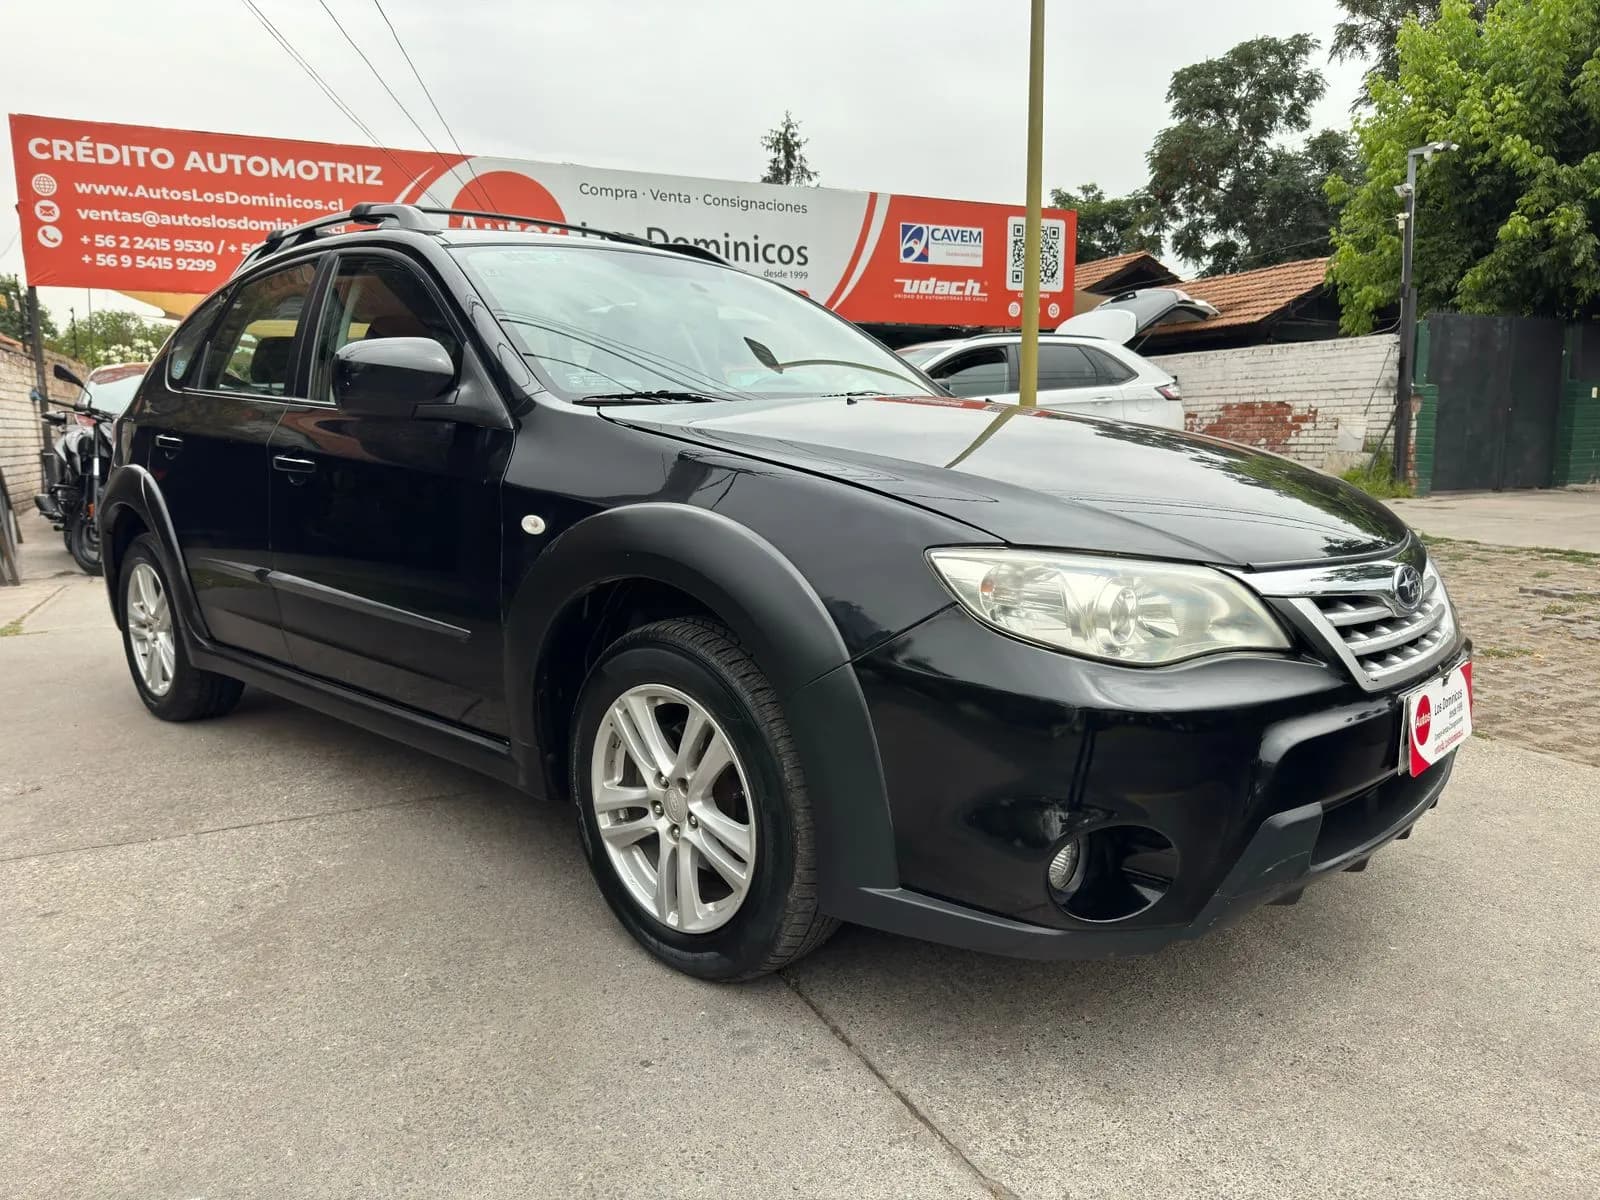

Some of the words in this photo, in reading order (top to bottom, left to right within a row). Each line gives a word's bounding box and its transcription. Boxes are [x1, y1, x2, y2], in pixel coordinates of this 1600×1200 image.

[28, 136, 175, 170] CRÉDITO
[184, 151, 384, 186] AUTOMOTRIZ
[74, 182, 344, 211] www.AutosLosDominicos.cl
[579, 183, 638, 201] Compra
[650, 188, 691, 204] Venta
[703, 194, 808, 214] Consignaciones
[95, 234, 116, 248] 56
[119, 235, 130, 249] 2
[134, 236, 171, 250] 2415
[174, 239, 214, 254] 9530
[931, 228, 982, 244] CAVEM
[96, 254, 117, 267] 56
[121, 255, 132, 268] 9
[136, 256, 173, 270] 5415
[176, 258, 216, 272] 9299
[763, 268, 787, 279] desde
[789, 270, 808, 280] 1999
[894, 277, 988, 297] udach
